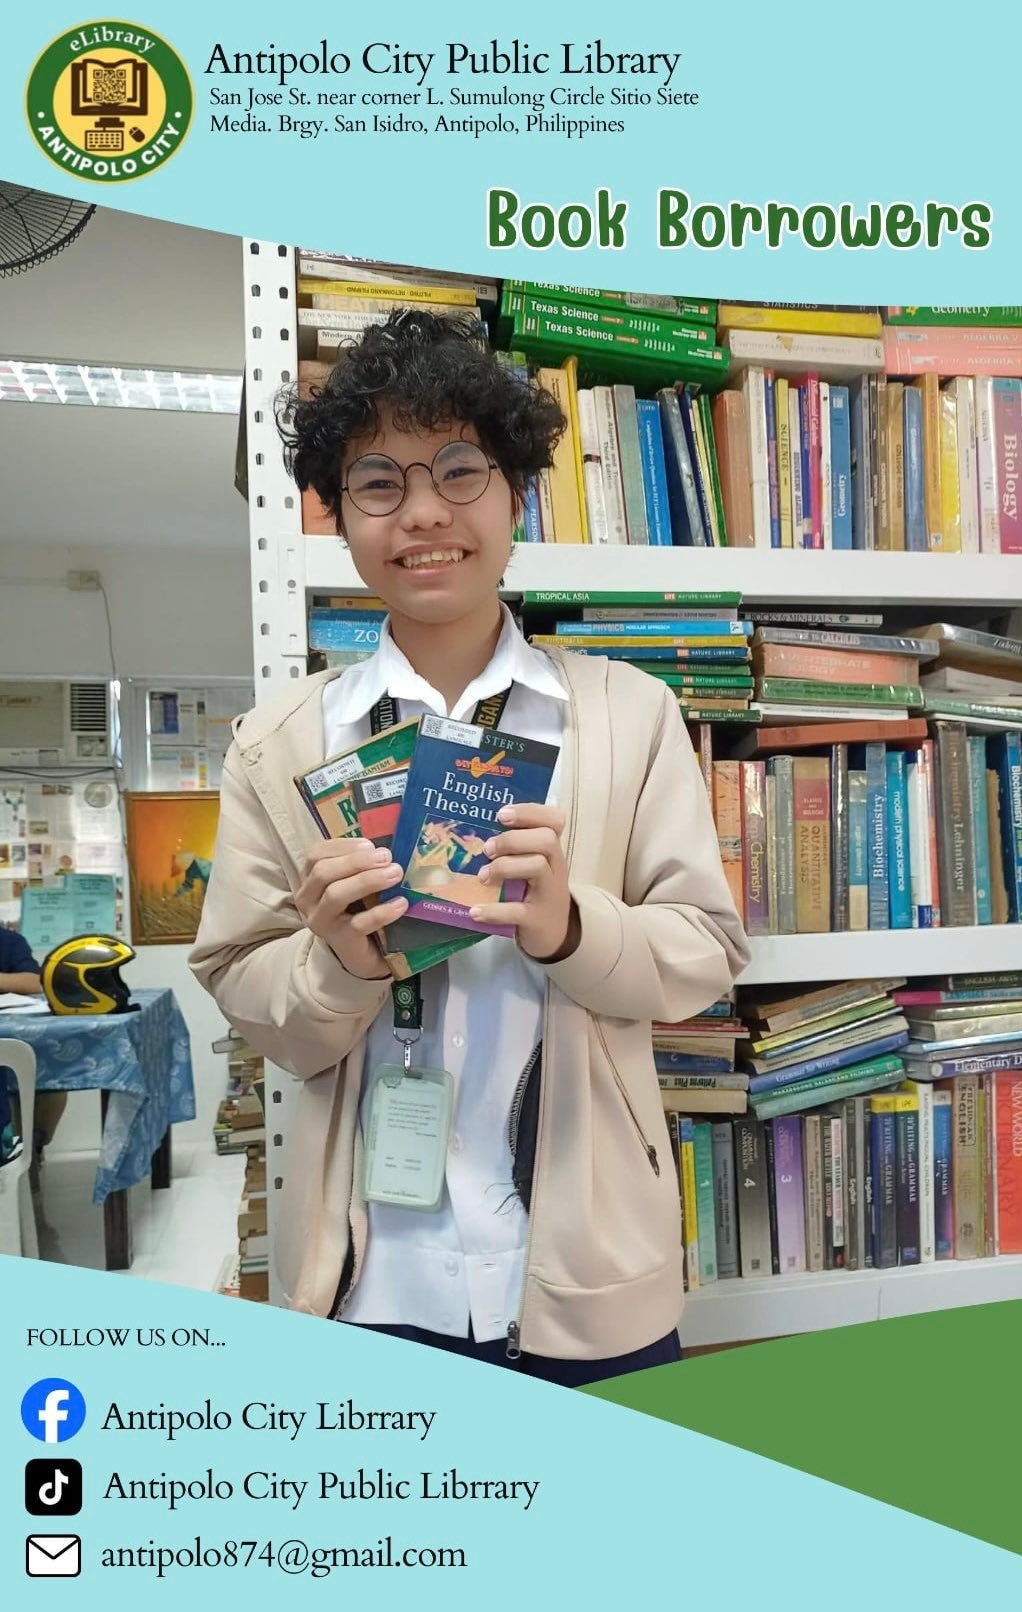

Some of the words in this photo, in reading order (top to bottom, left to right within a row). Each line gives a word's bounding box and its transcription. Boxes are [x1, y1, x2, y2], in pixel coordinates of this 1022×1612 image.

[562, 283, 600, 298] Science
[530, 300, 558, 316] Texas
[561, 304, 599, 322] Science
[545, 321, 573, 336] Texas
[575, 326, 614, 342] Science
[837, 473, 847, 517] Geometry
[1002, 434, 1019, 520] Biology
[536, 592, 571, 601] TROPICAL
[572, 592, 589, 601] ASIA
[592, 623, 625, 632] PHYSICS
[441, 771, 515, 807] English
[893, 791, 902, 824] modern
[1011, 765, 1022, 829] Biochemistry
[800, 825, 810, 884] ANALYSIS
[873, 794, 885, 878] Biochemistry
[894, 825, 904, 858] physical
[750, 840, 765, 903] Chemistry
[810, 825, 821, 910] QUANTITATIVE
[896, 859, 906, 891] science
[953, 822, 965, 892] Lehninger
[954, 1055, 1012, 1072] Elementary
[674, 1077, 688, 1088] Plus
[689, 1077, 716, 1088] Patterns
[1011, 1080, 1022, 1109] NEW
[958, 1084, 967, 1145] ENGLISH
[966, 1085, 974, 1141] FRESHMAN
[884, 1117, 893, 1155] WRITING
[907, 1115, 915, 1153] WRITING
[998, 1084, 1015, 1216] DICTIONARY
[1012, 1111, 1022, 1158] WORLD
[700, 1179, 710, 1188] 1
[743, 1177, 756, 1189] 4
[780, 1174, 793, 1184] 3
[885, 1164, 893, 1206] GRAMMAR
[908, 1162, 916, 1202] GRAMMAR
